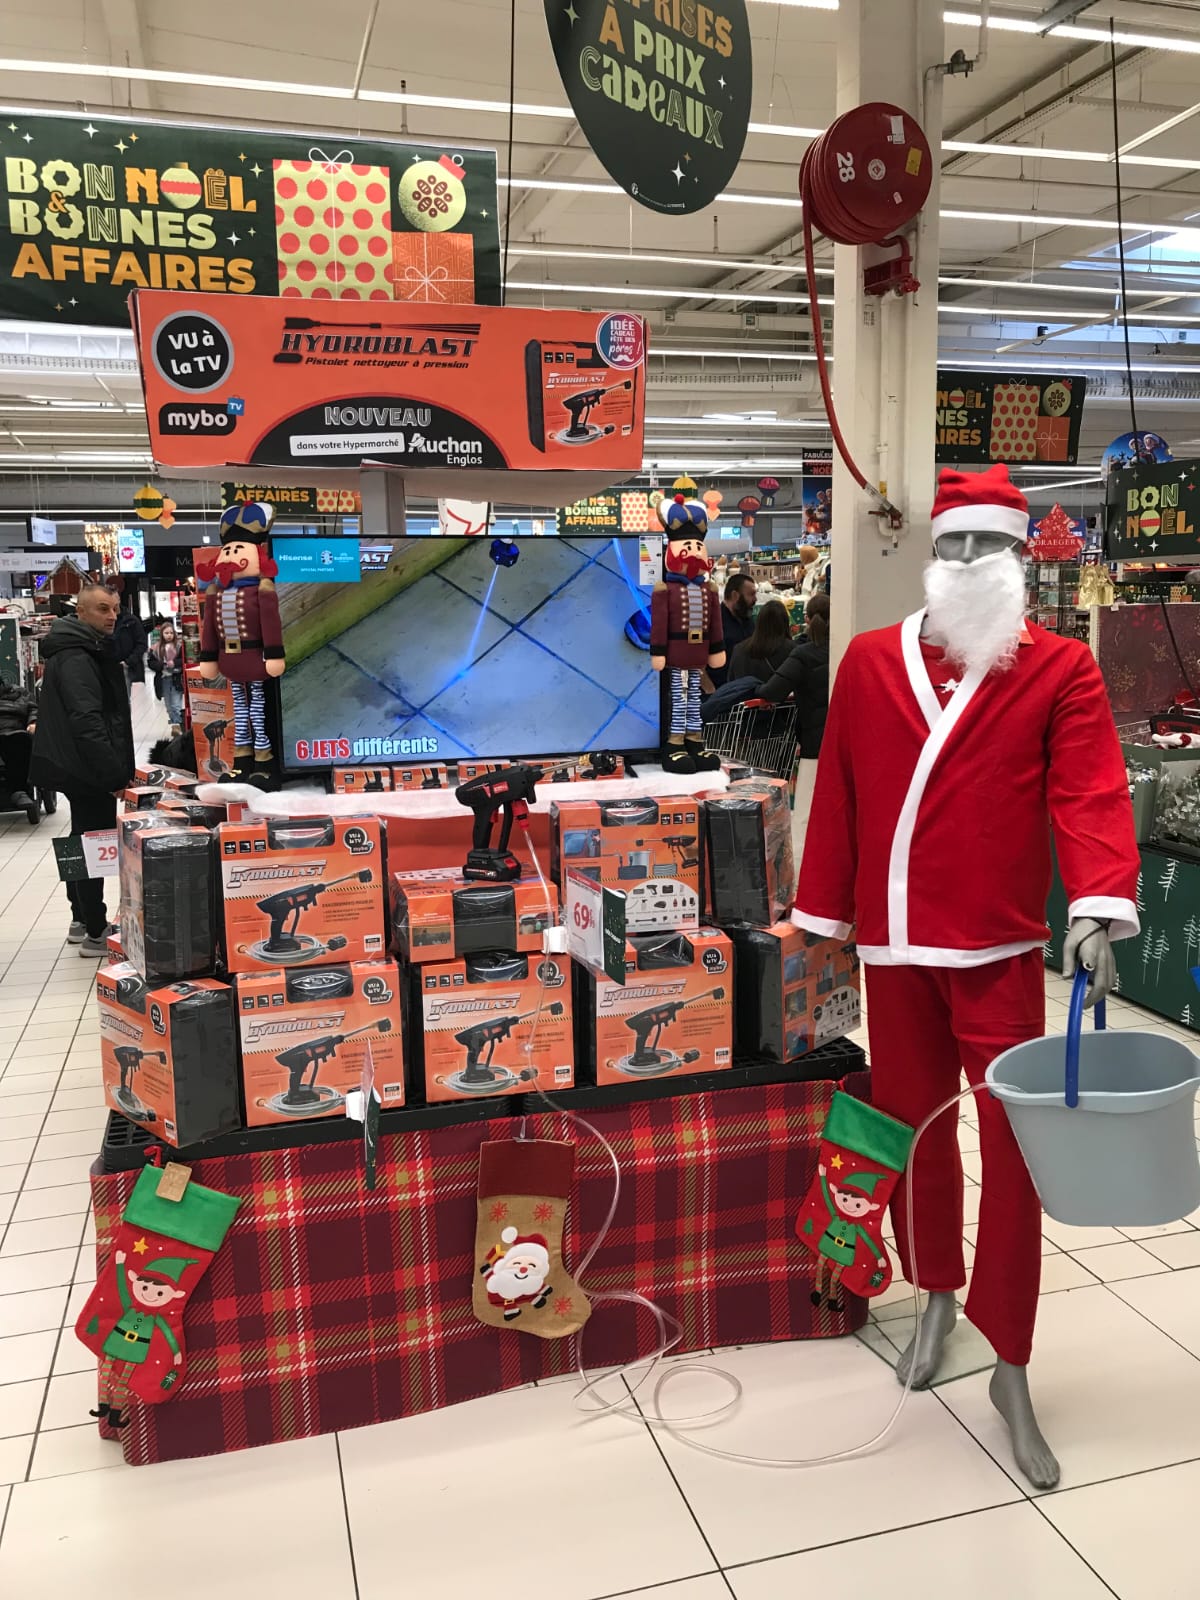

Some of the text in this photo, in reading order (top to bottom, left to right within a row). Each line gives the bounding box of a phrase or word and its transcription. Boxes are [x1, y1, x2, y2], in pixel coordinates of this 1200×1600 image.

[634, 19, 706, 95] PRIX
[836, 152, 856, 183] 28
[5, 157, 257, 214] BON NOËL
[8, 199, 217, 249] BONNES
[11, 243, 257, 293] AFFAIRES
[610, 319, 635, 330] IDÉE
[168, 330, 215, 350] VU à
[281, 332, 479, 357] HYDROBLAST
[171, 355, 221, 375] la TV
[305, 357, 469, 369] Pistolet nettoyeur à pression
[167, 402, 242, 430] mybo TV
[324, 406, 432, 427] NOUVEAU
[296, 438, 399, 451] dans votre Hypermarché
[408, 433, 482, 453] Auchan
[447, 454, 483, 467] Englos
[234, 489, 310, 503] AFFAIRES
[1127, 484, 1178, 512] BON
[565, 506, 609, 516] BONNES
[565, 516, 618, 525] AFFAIRES
[1126, 508, 1194, 538] NOËL
[1036, 538, 1076, 546] DRAEGER
[279, 553, 312, 561] Hisense
[296, 734, 438, 760] 6 JETS différents
[98, 845, 118, 861] 29
[230, 866, 325, 882] HYDROBLAST
